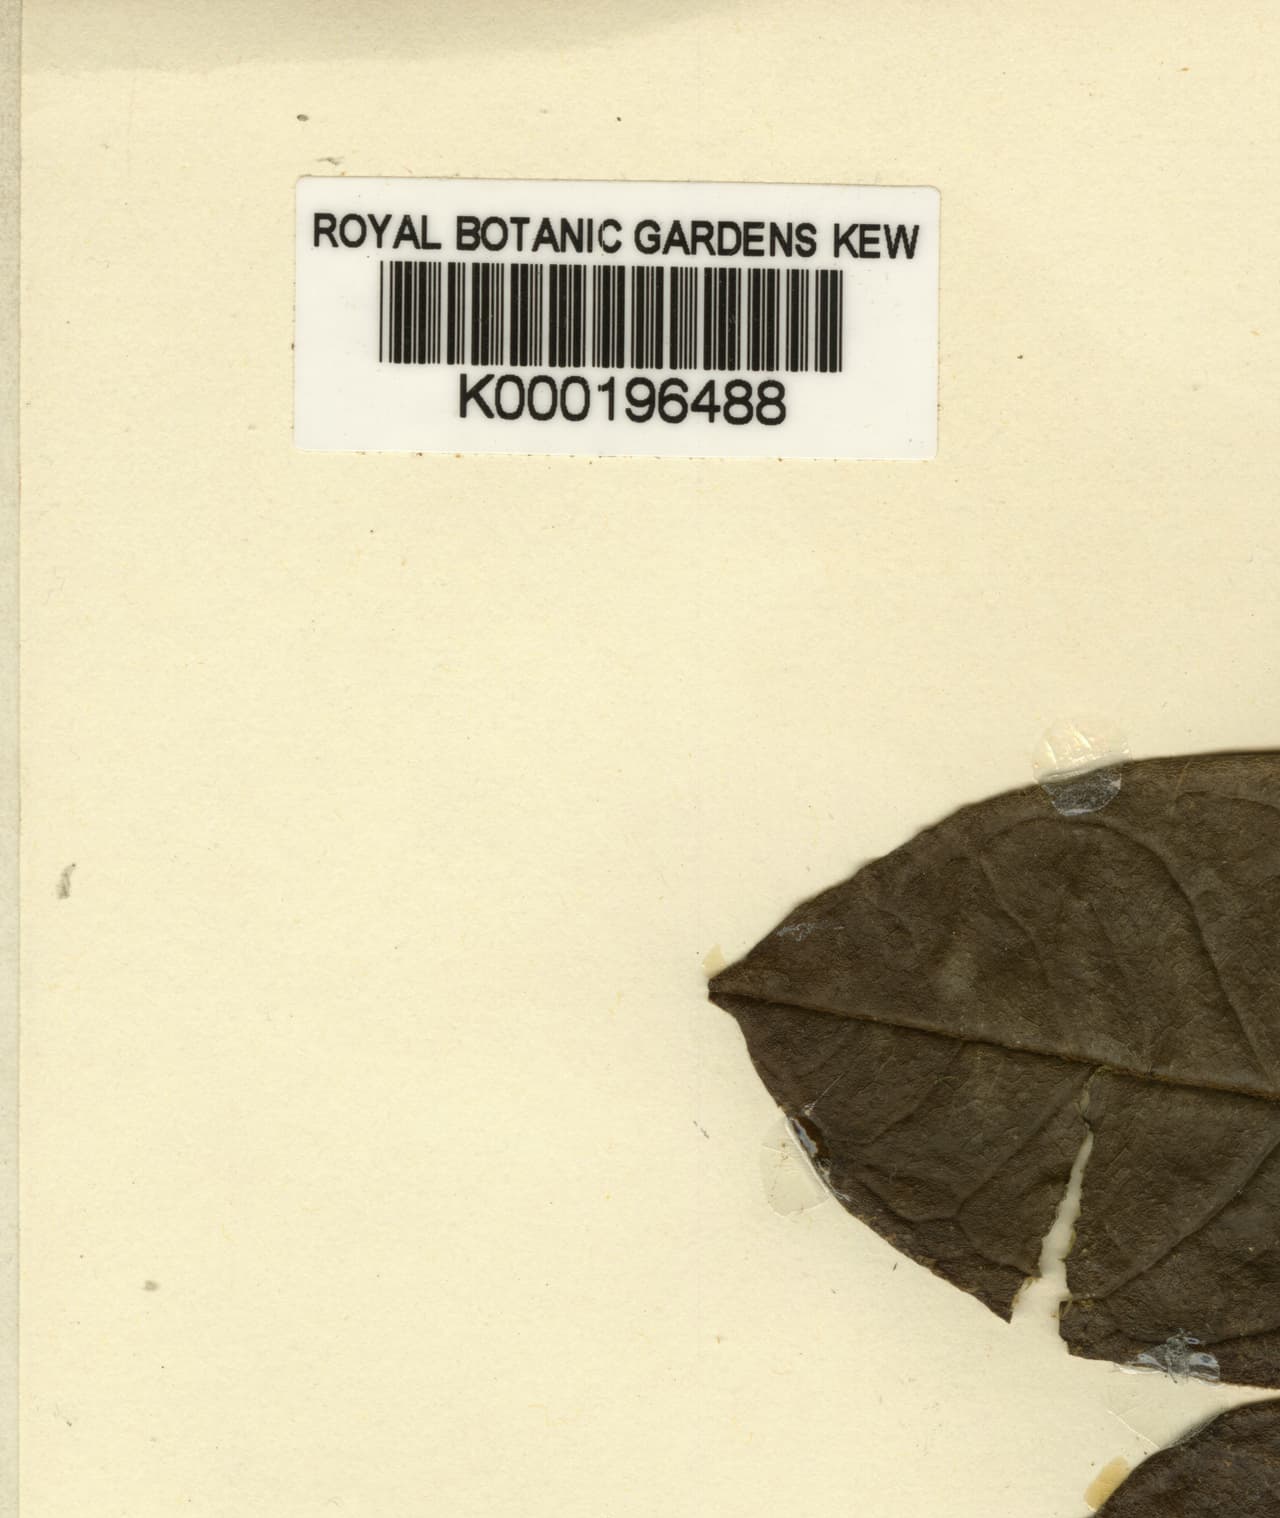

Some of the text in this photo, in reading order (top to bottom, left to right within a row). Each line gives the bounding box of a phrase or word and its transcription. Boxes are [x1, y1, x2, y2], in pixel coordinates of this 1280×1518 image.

[313, 212, 920, 260] ROYAL BOTANIC GARDENS KEW
[459, 373, 787, 426] K000196488
